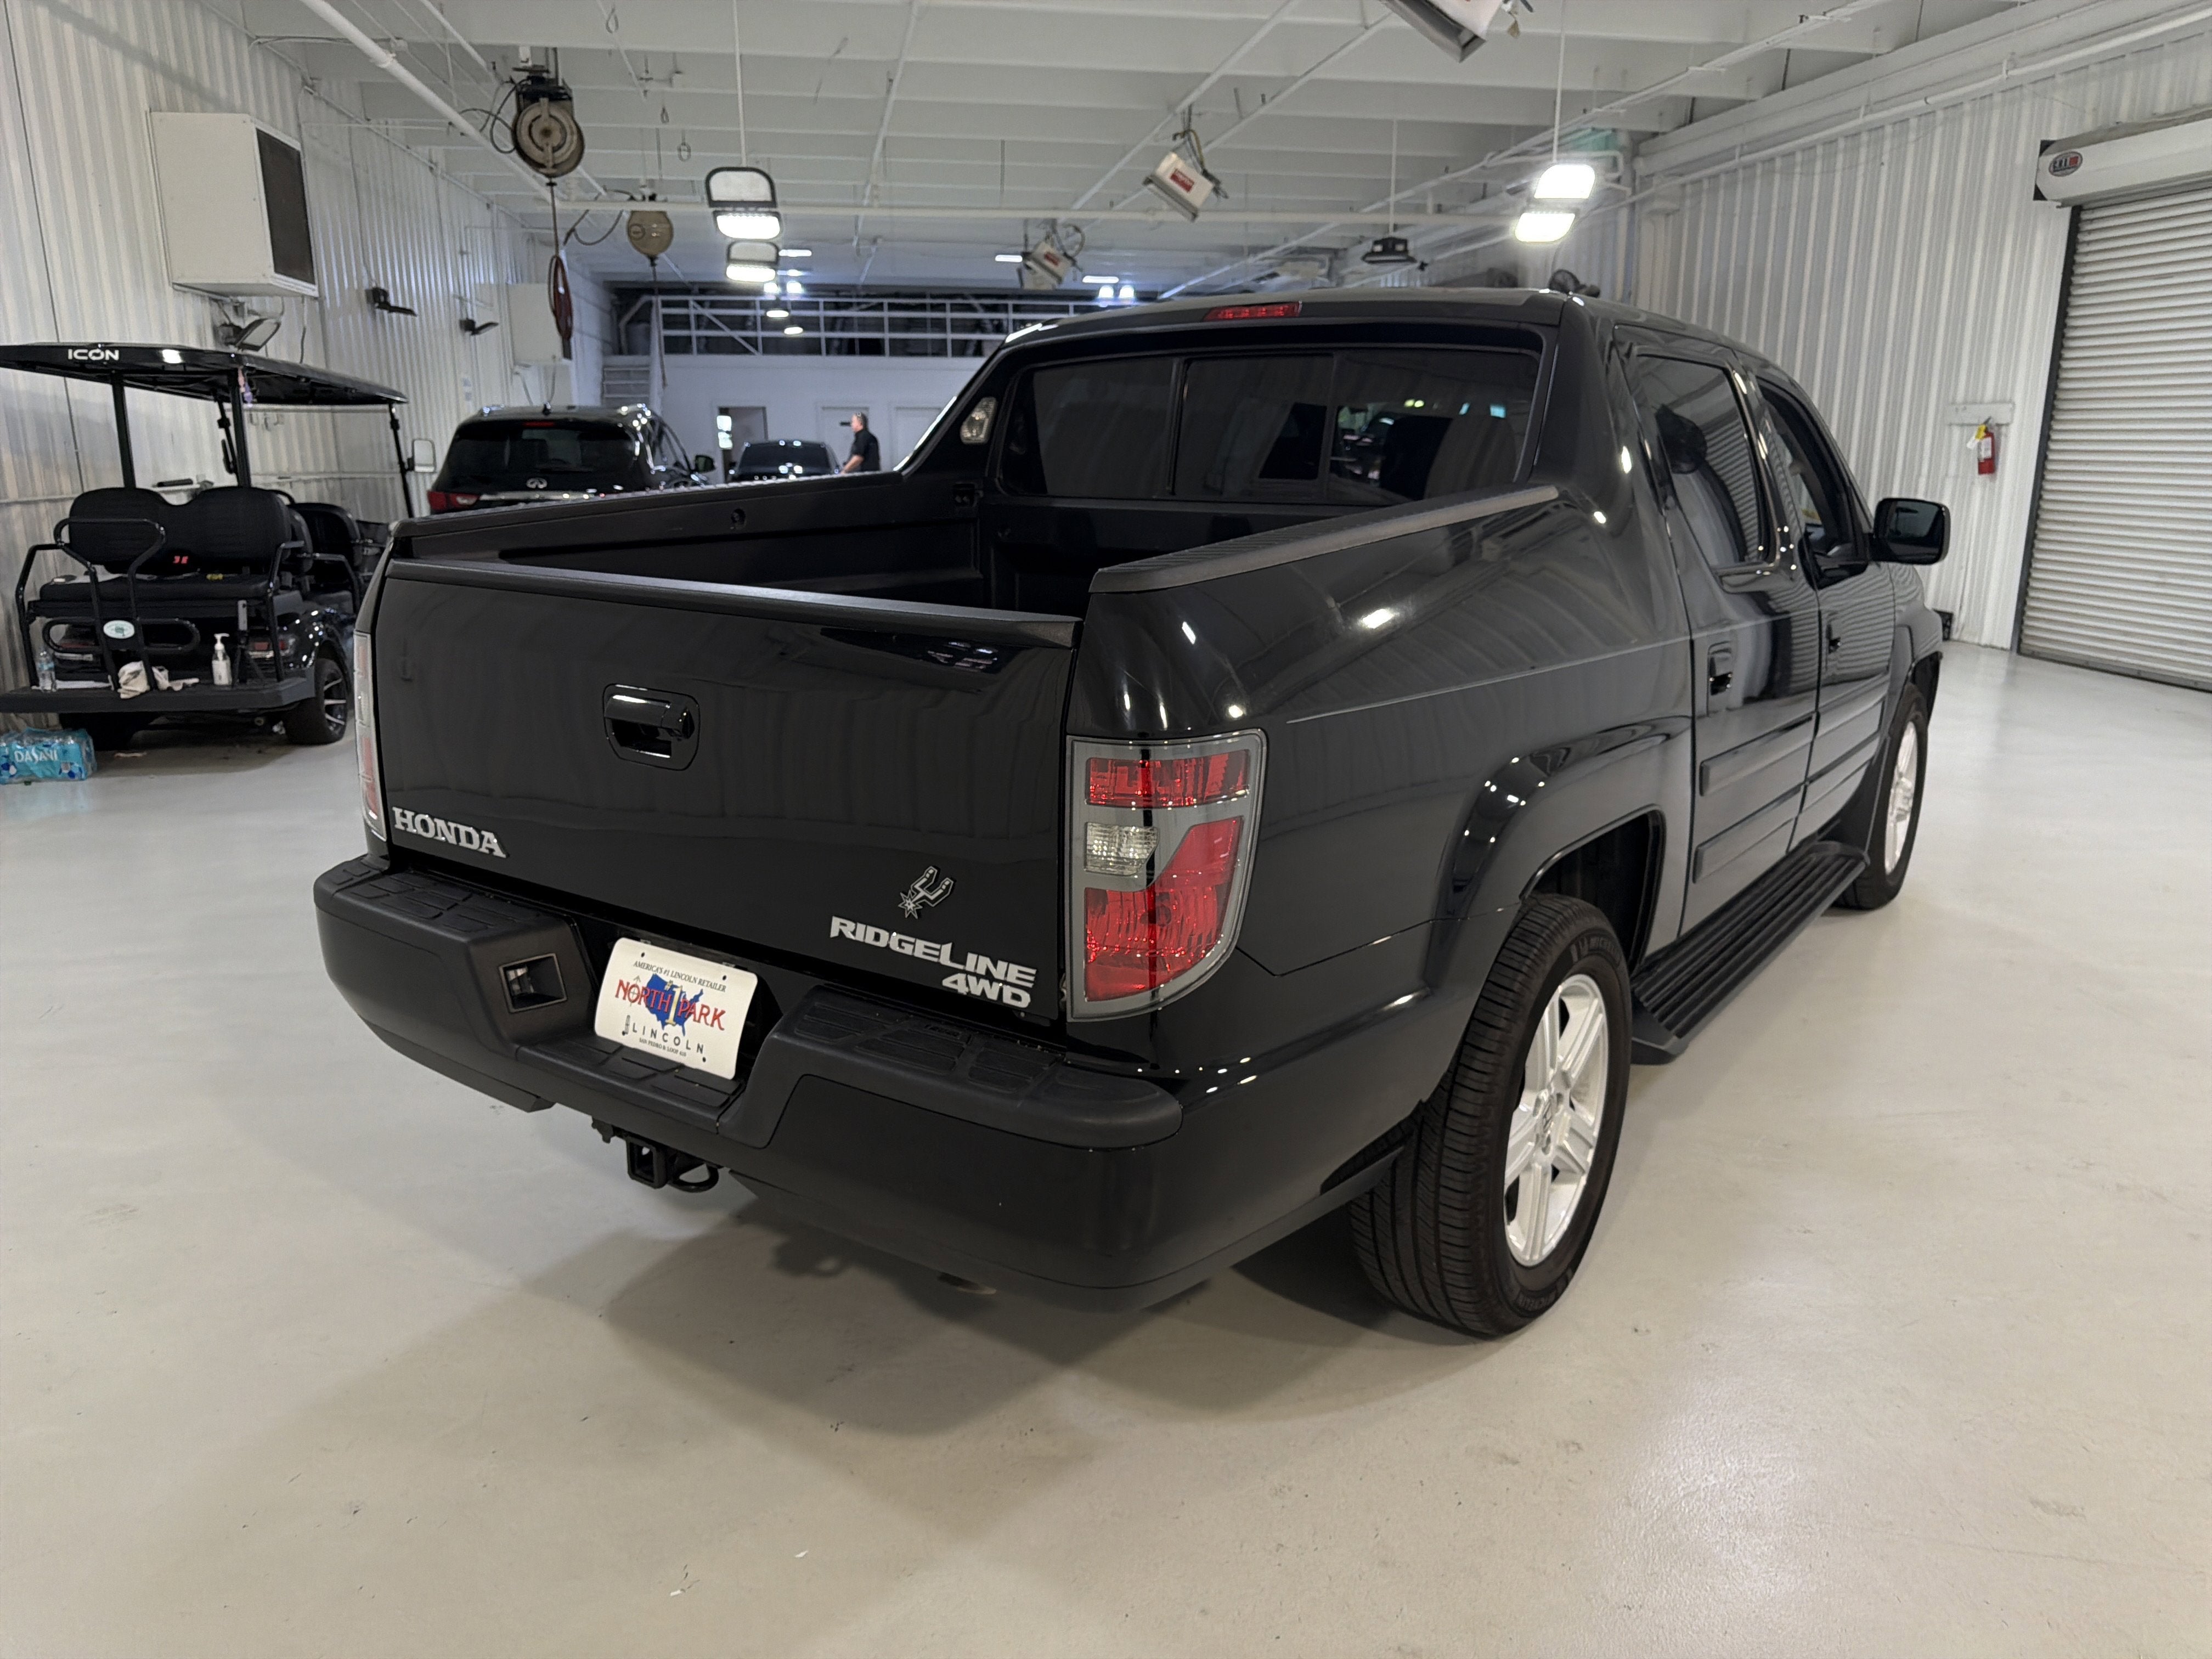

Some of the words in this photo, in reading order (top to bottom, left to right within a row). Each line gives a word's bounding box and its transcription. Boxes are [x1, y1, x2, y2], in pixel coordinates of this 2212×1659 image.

[68, 348, 119, 360] ICON
[14, 747, 58, 764] DASANI
[392, 806, 506, 858] HONDA
[830, 916, 1037, 988] RIDGELINE
[633, 961, 663, 974] AMERICA'S
[670, 970, 698, 984] LINCOLN
[698, 978, 727, 992] RETAILER
[942, 973, 1031, 1008] 4WD
[615, 979, 673, 1012] NORTH
[677, 998, 725, 1031] PARK
[633, 1022, 704, 1054] LINCOLN
